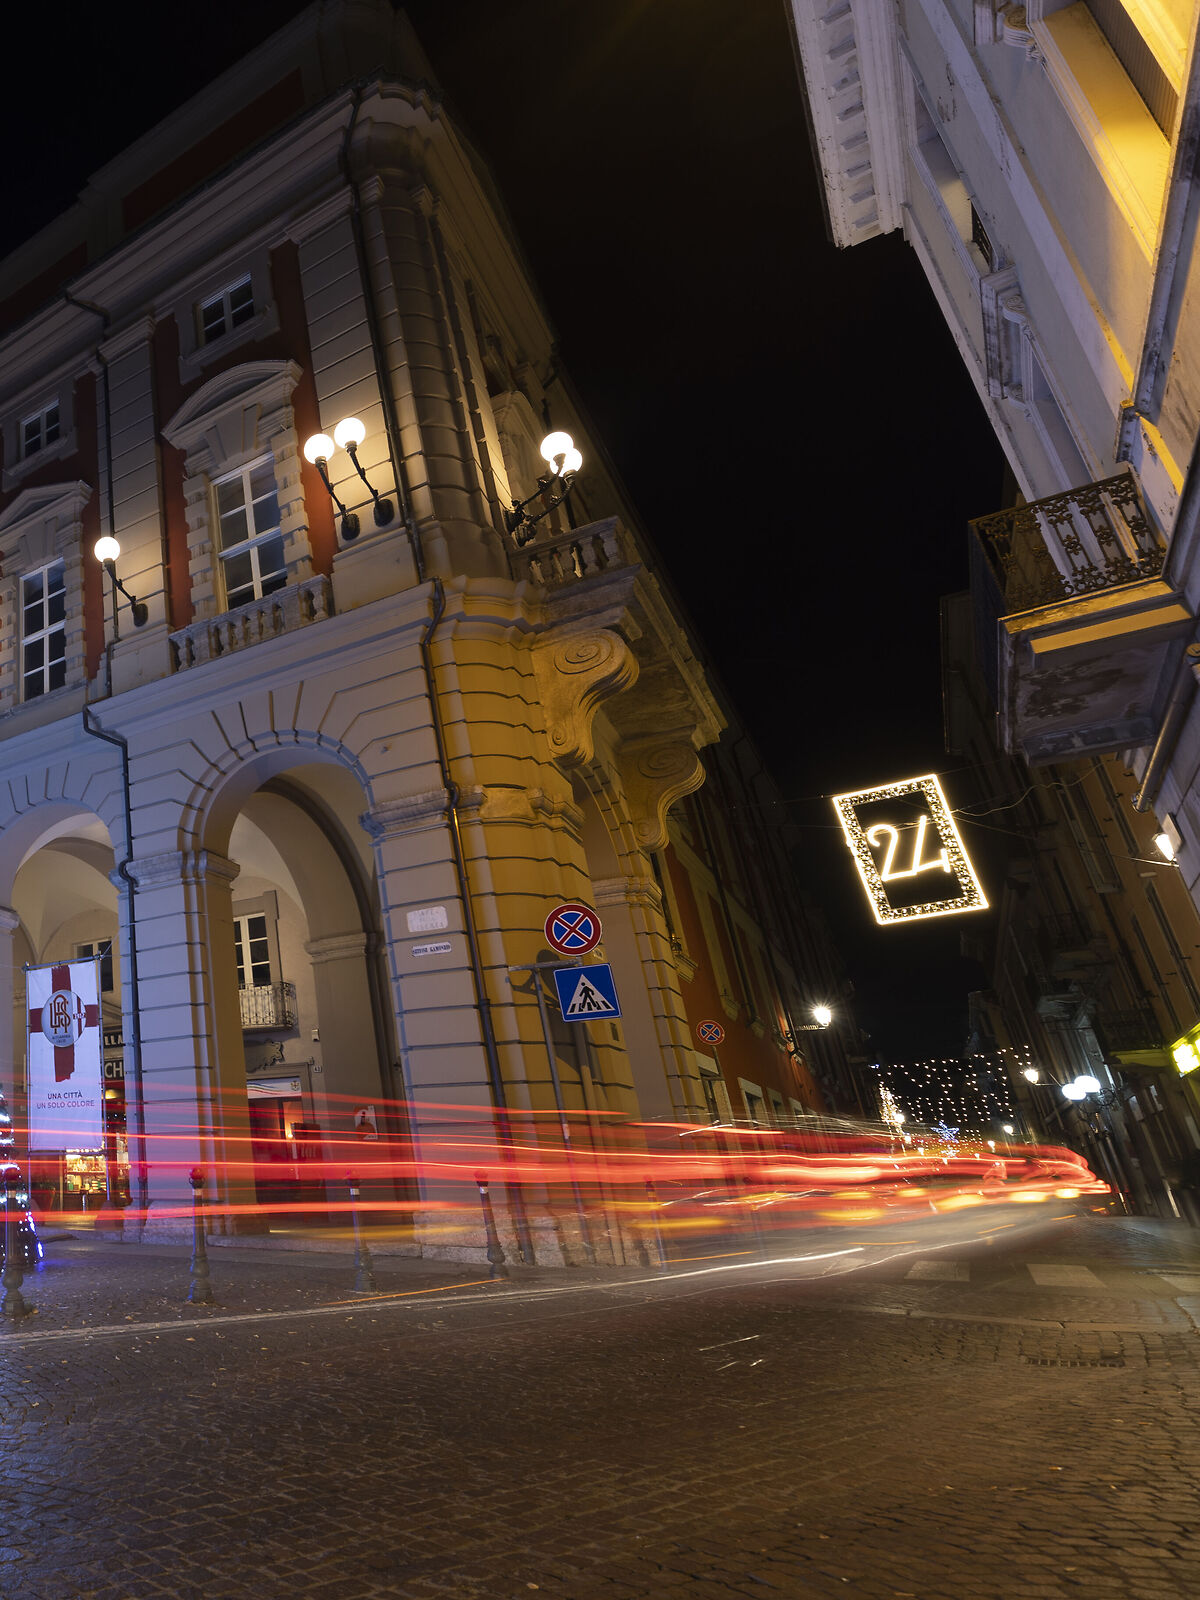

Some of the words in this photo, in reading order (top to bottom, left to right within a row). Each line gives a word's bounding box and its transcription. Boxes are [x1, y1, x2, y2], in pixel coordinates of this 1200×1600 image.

[866, 815, 952, 882] 24
[63, 1090, 83, 1099] CITTÀ
[47, 1101, 66, 1109] SOLO
[66, 1100, 95, 1108] COLORE
